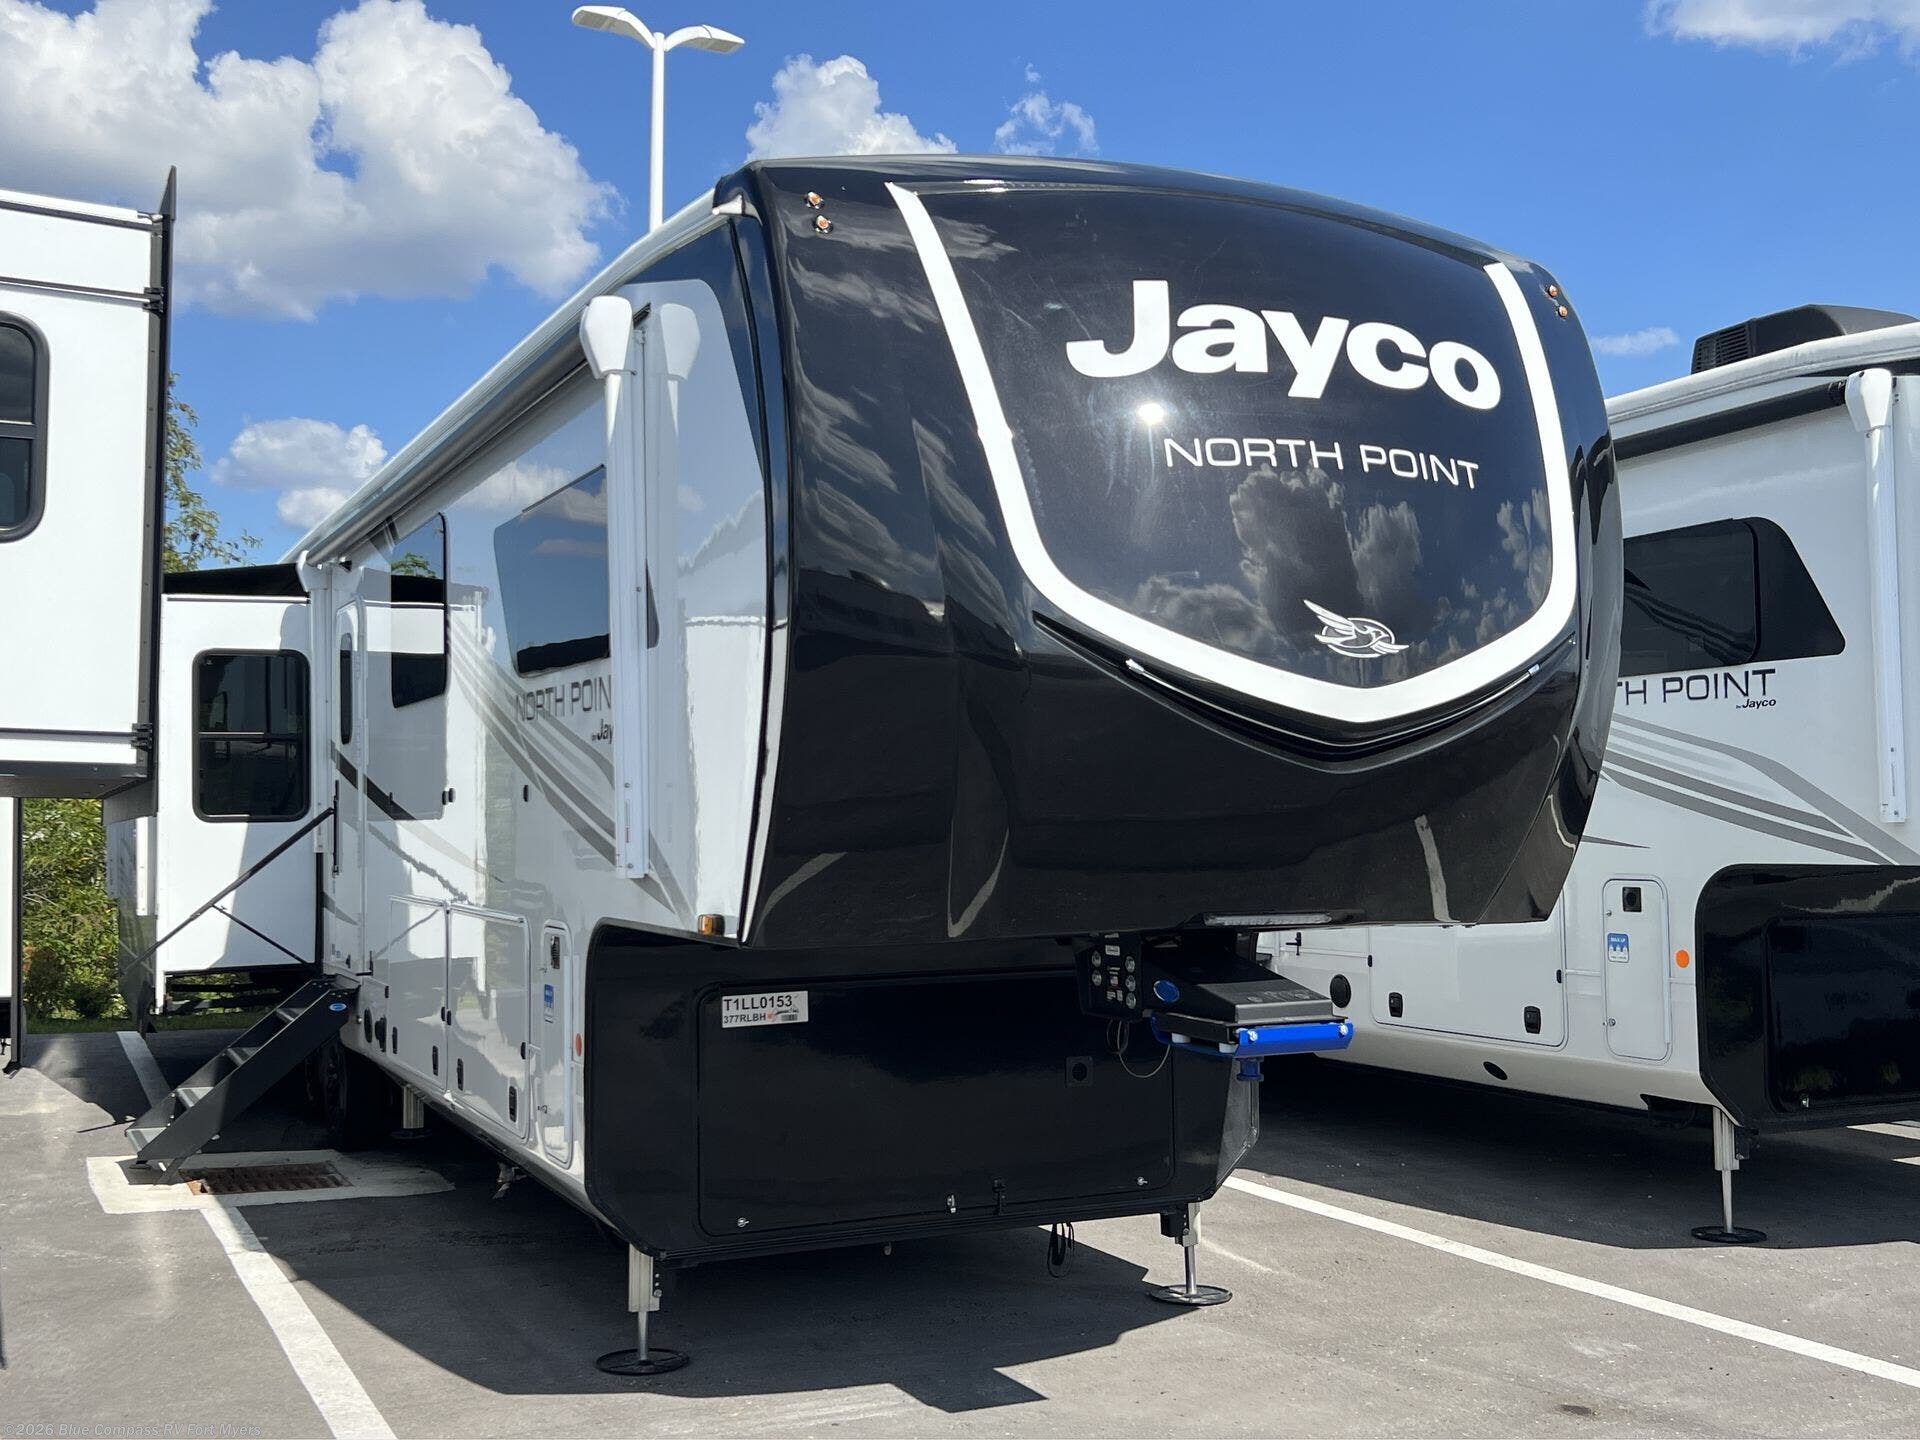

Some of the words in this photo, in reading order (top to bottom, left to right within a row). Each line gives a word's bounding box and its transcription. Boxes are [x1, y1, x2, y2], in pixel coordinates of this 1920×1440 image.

[1066, 279, 1501, 410] Jayco
[1163, 437, 1344, 470] NORTH
[1359, 443, 1479, 489] POINT
[514, 684, 565, 722] NORTH
[571, 674, 612, 716] POIN
[1662, 668, 1776, 704] POINT
[1742, 698, 1777, 710] Jayco
[597, 718, 614, 745] Jay
[723, 994, 793, 1011] T1LL0153
[723, 1012, 766, 1024] 377RLBH
